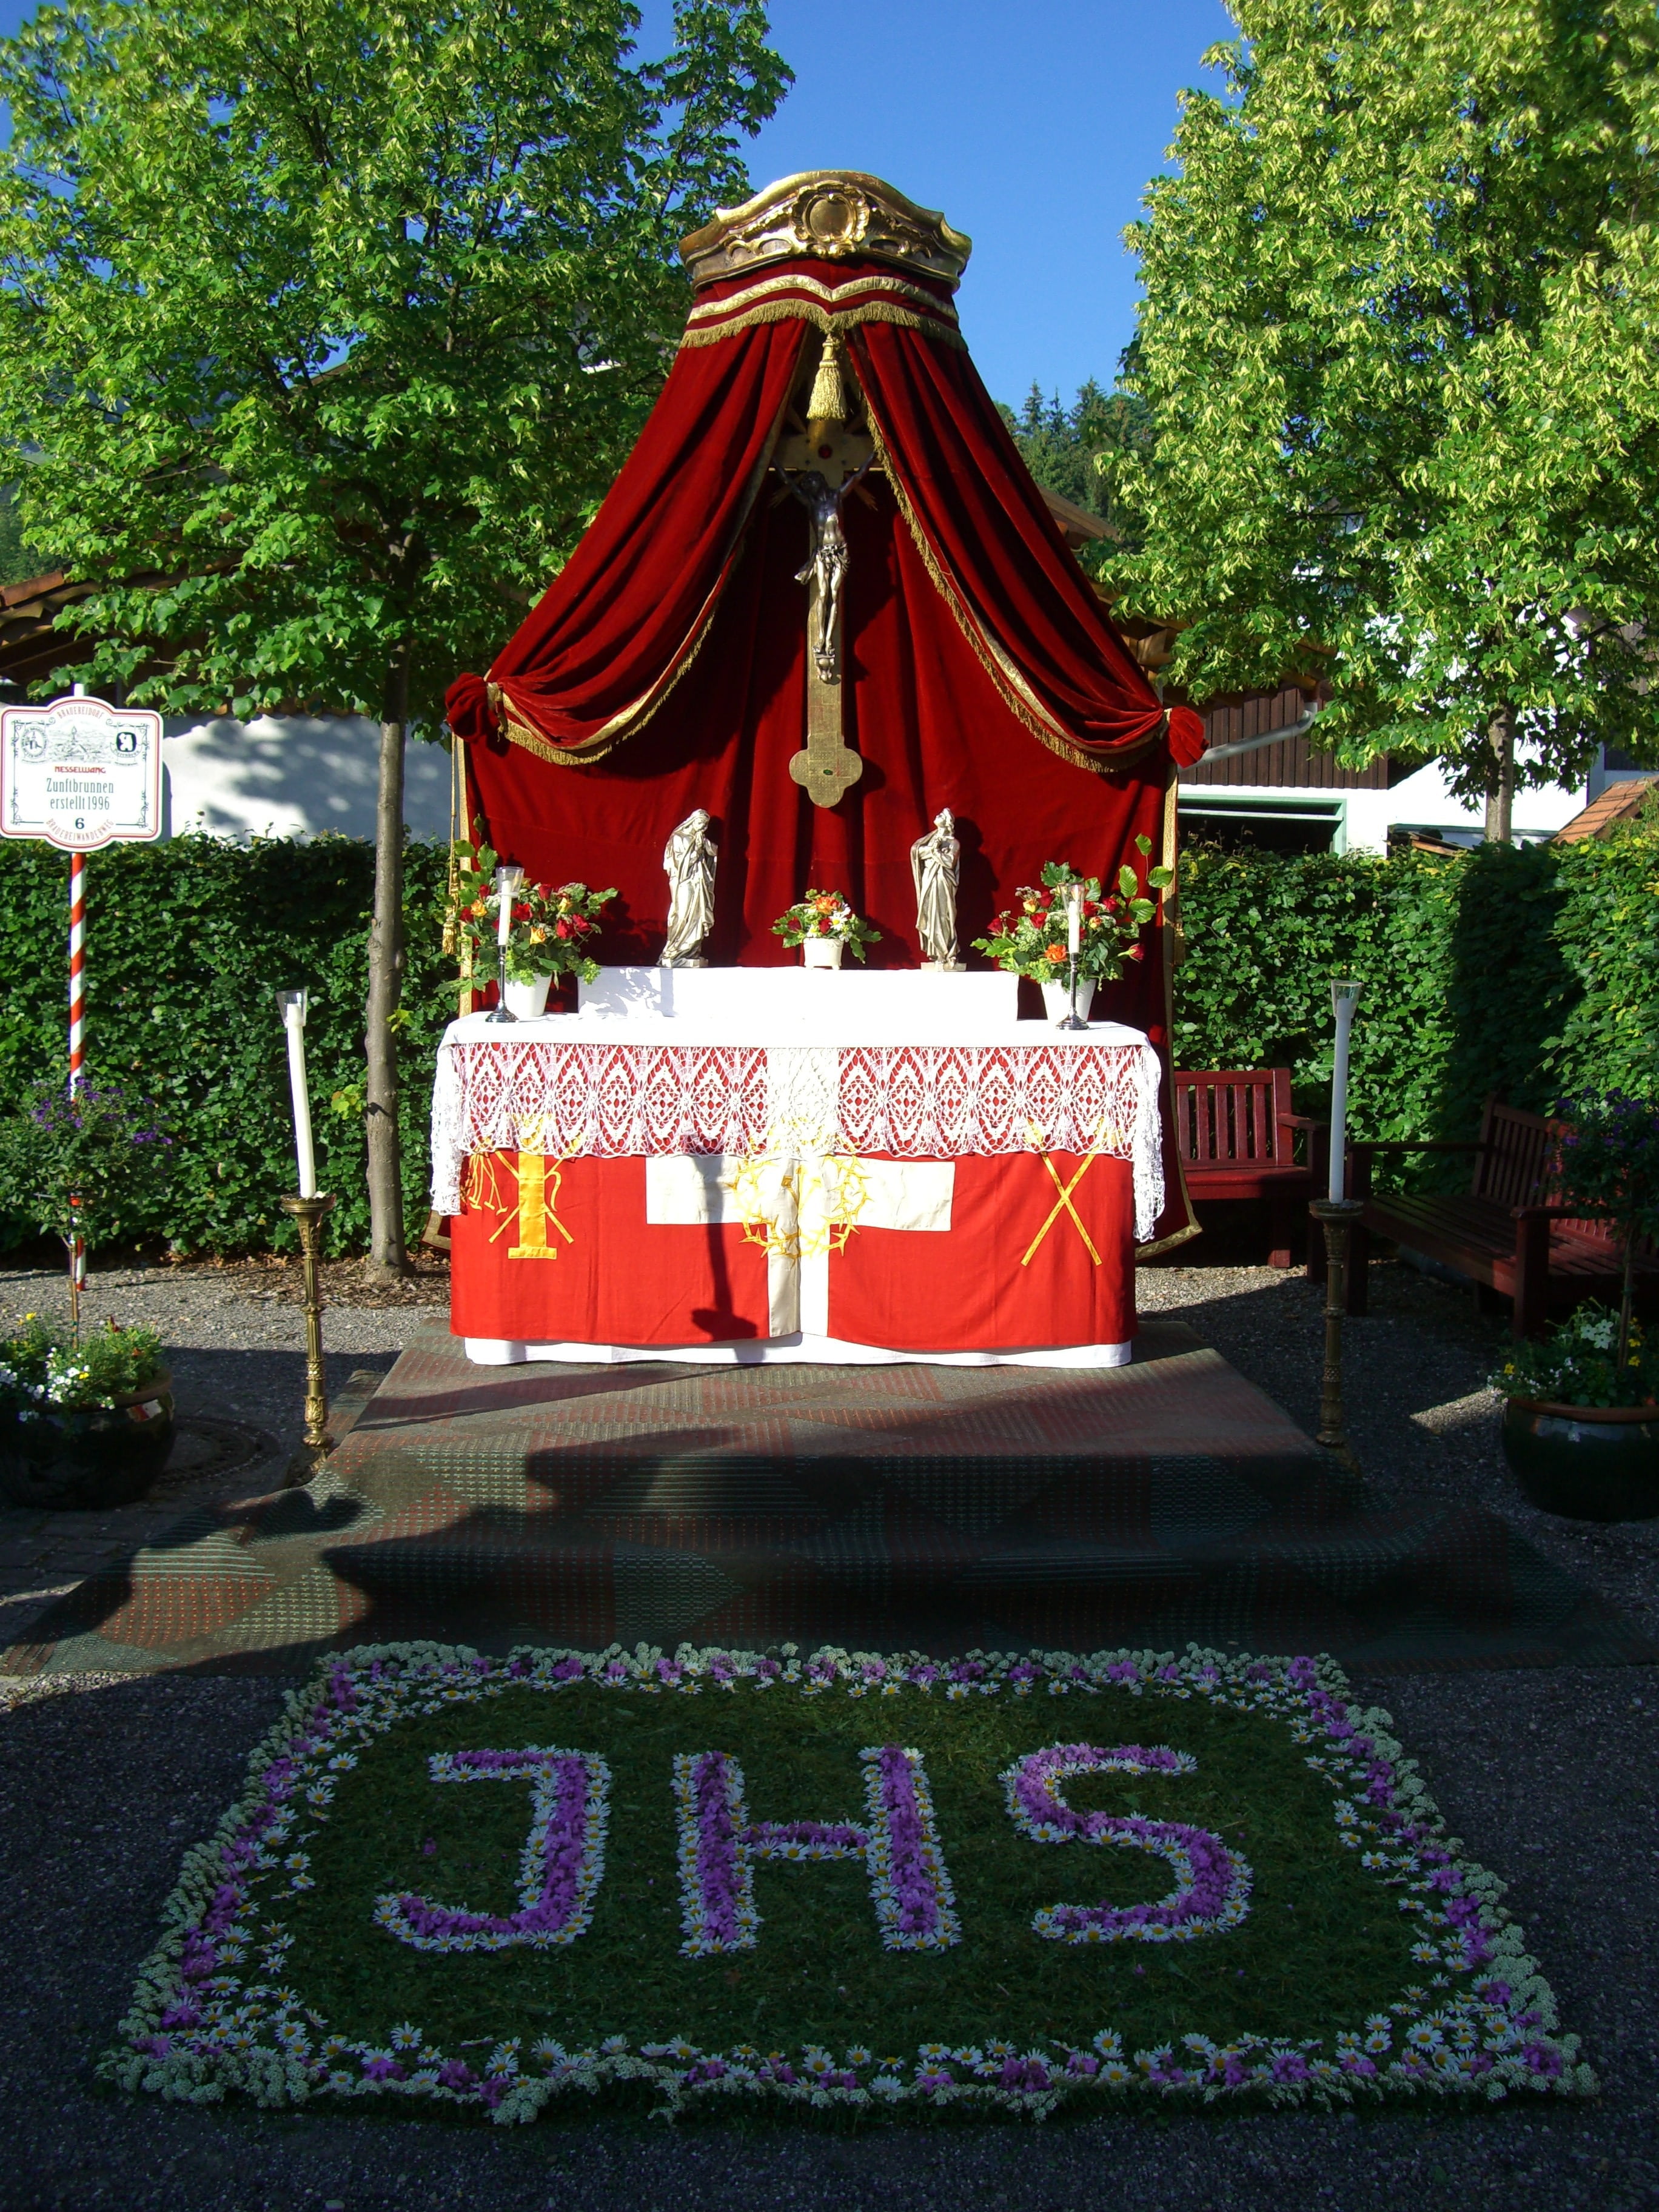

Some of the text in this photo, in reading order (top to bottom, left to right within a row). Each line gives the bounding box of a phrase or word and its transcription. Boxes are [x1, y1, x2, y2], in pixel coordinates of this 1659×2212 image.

[57, 706, 104, 719] BRAUEREIDORF
[46, 777, 114, 793] Zunftbrunnen
[50, 795, 110, 810] erstellt 1996
[75, 817, 85, 830] 6
[374, 1743, 1255, 1959] JHS
